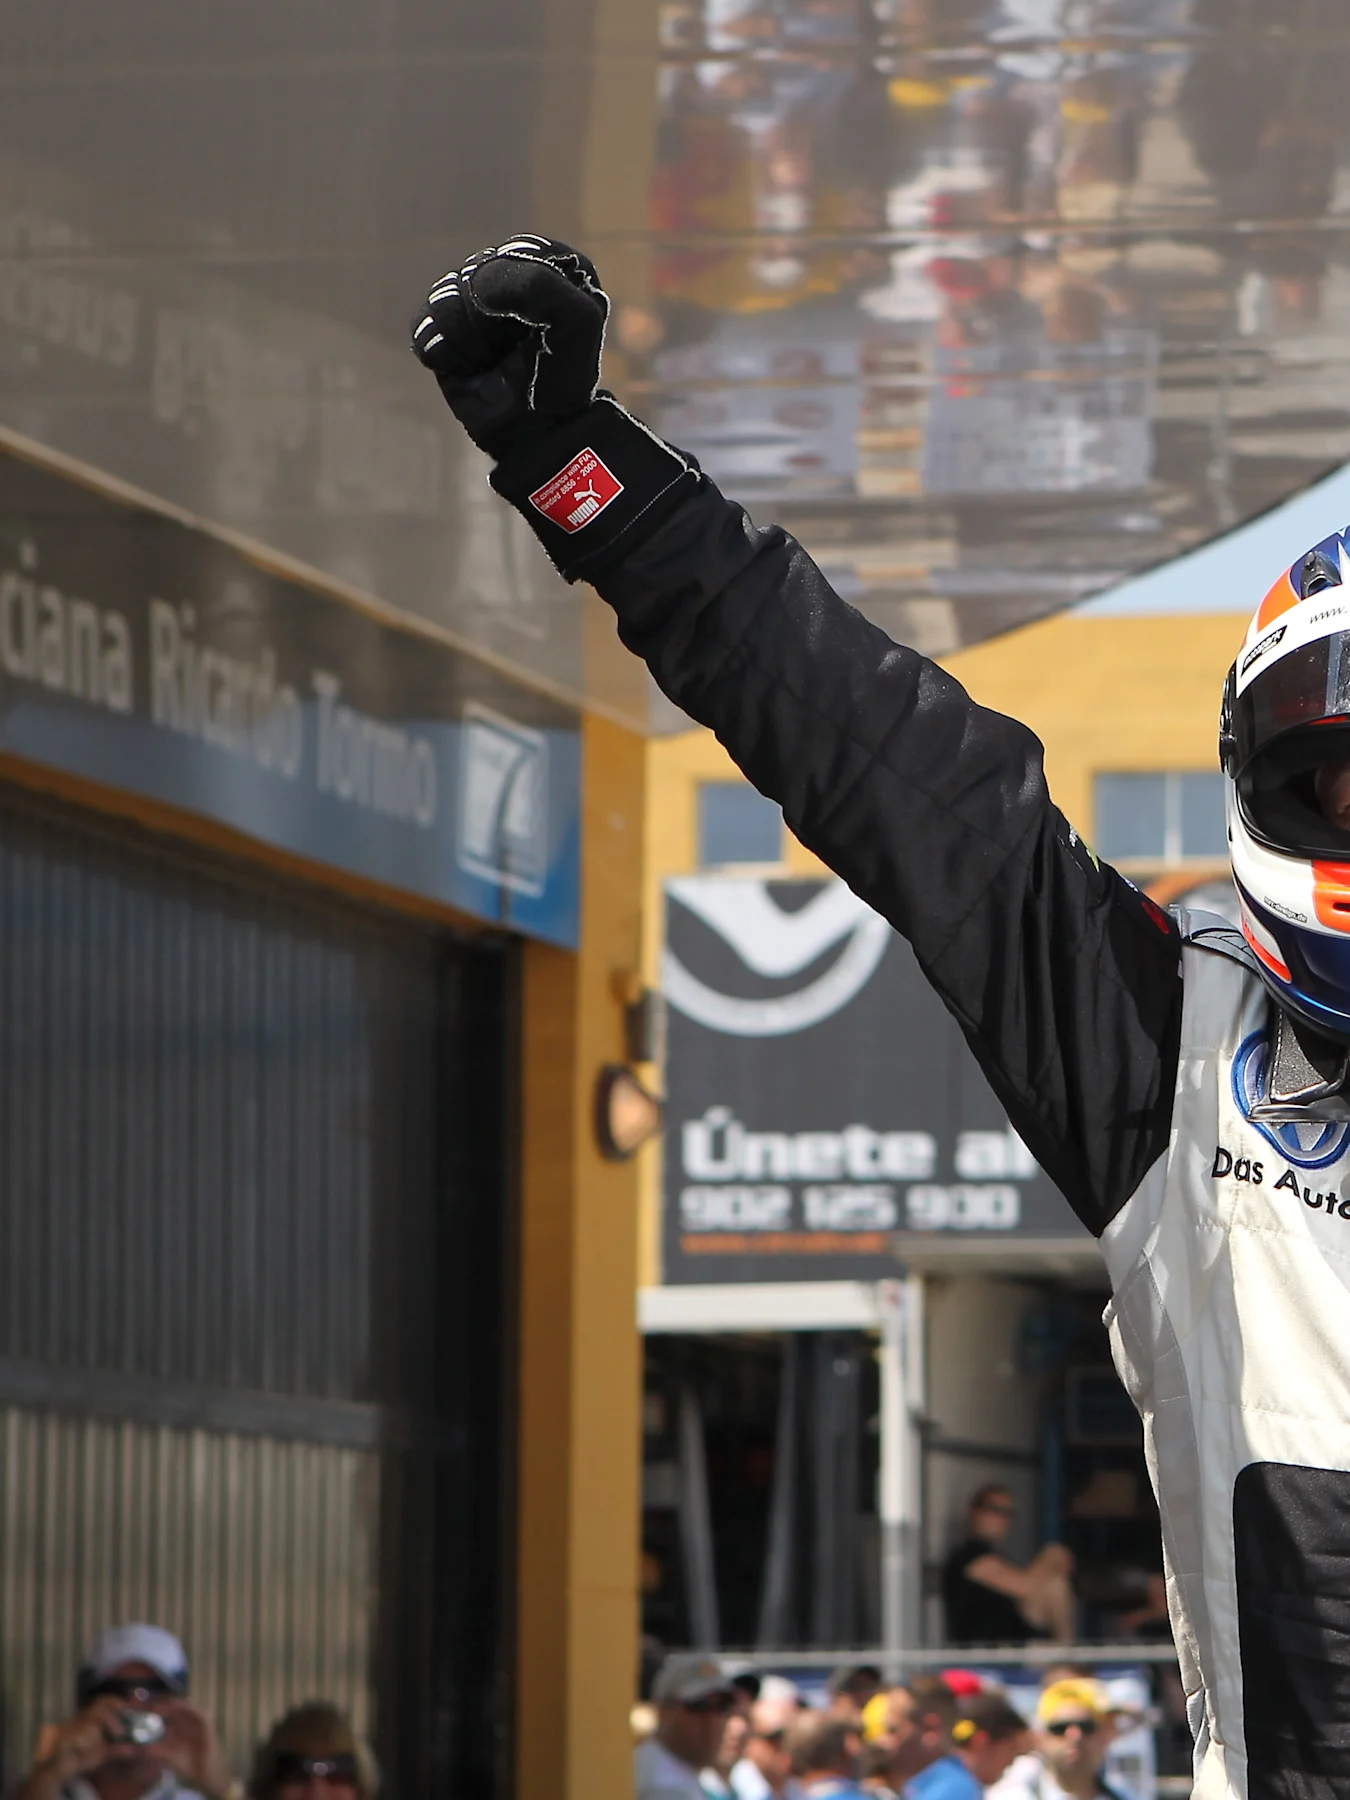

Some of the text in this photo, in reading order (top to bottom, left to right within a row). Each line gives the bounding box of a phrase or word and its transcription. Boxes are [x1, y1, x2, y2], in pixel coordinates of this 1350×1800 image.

[567, 463, 581, 477] with
[578, 452, 593, 466] FIA
[579, 459, 598, 477] 2000
[566, 496, 600, 527] PUMA
[681, 1104, 937, 1182] Únete
[1211, 1145, 1264, 1185] Das
[903, 1183, 1022, 1232] 900
